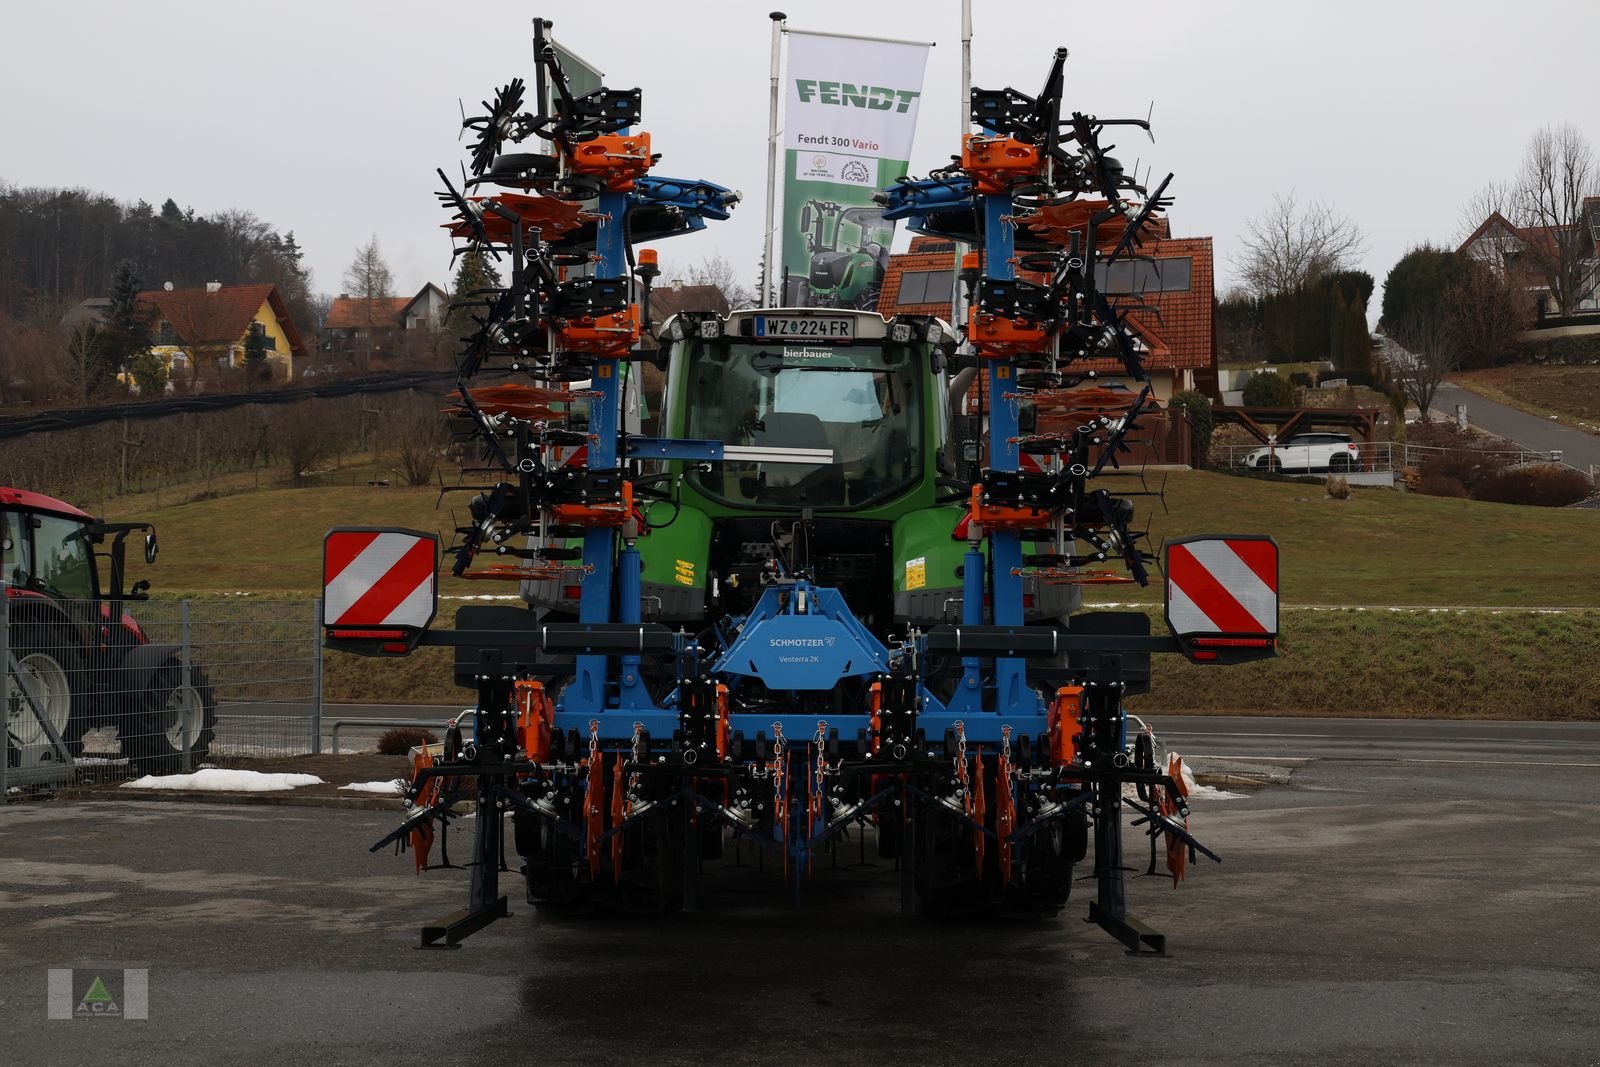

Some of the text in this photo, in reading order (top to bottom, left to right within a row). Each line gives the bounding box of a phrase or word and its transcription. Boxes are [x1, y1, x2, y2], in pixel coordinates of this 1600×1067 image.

[796, 79, 920, 113] FENDT
[798, 134, 879, 151] Fendt 300 Vario
[768, 320, 788, 335] WZ
[784, 346, 832, 358] bierbauer
[770, 639, 824, 647] SCHMOTZER
[779, 655, 819, 663] Venterra 2K
